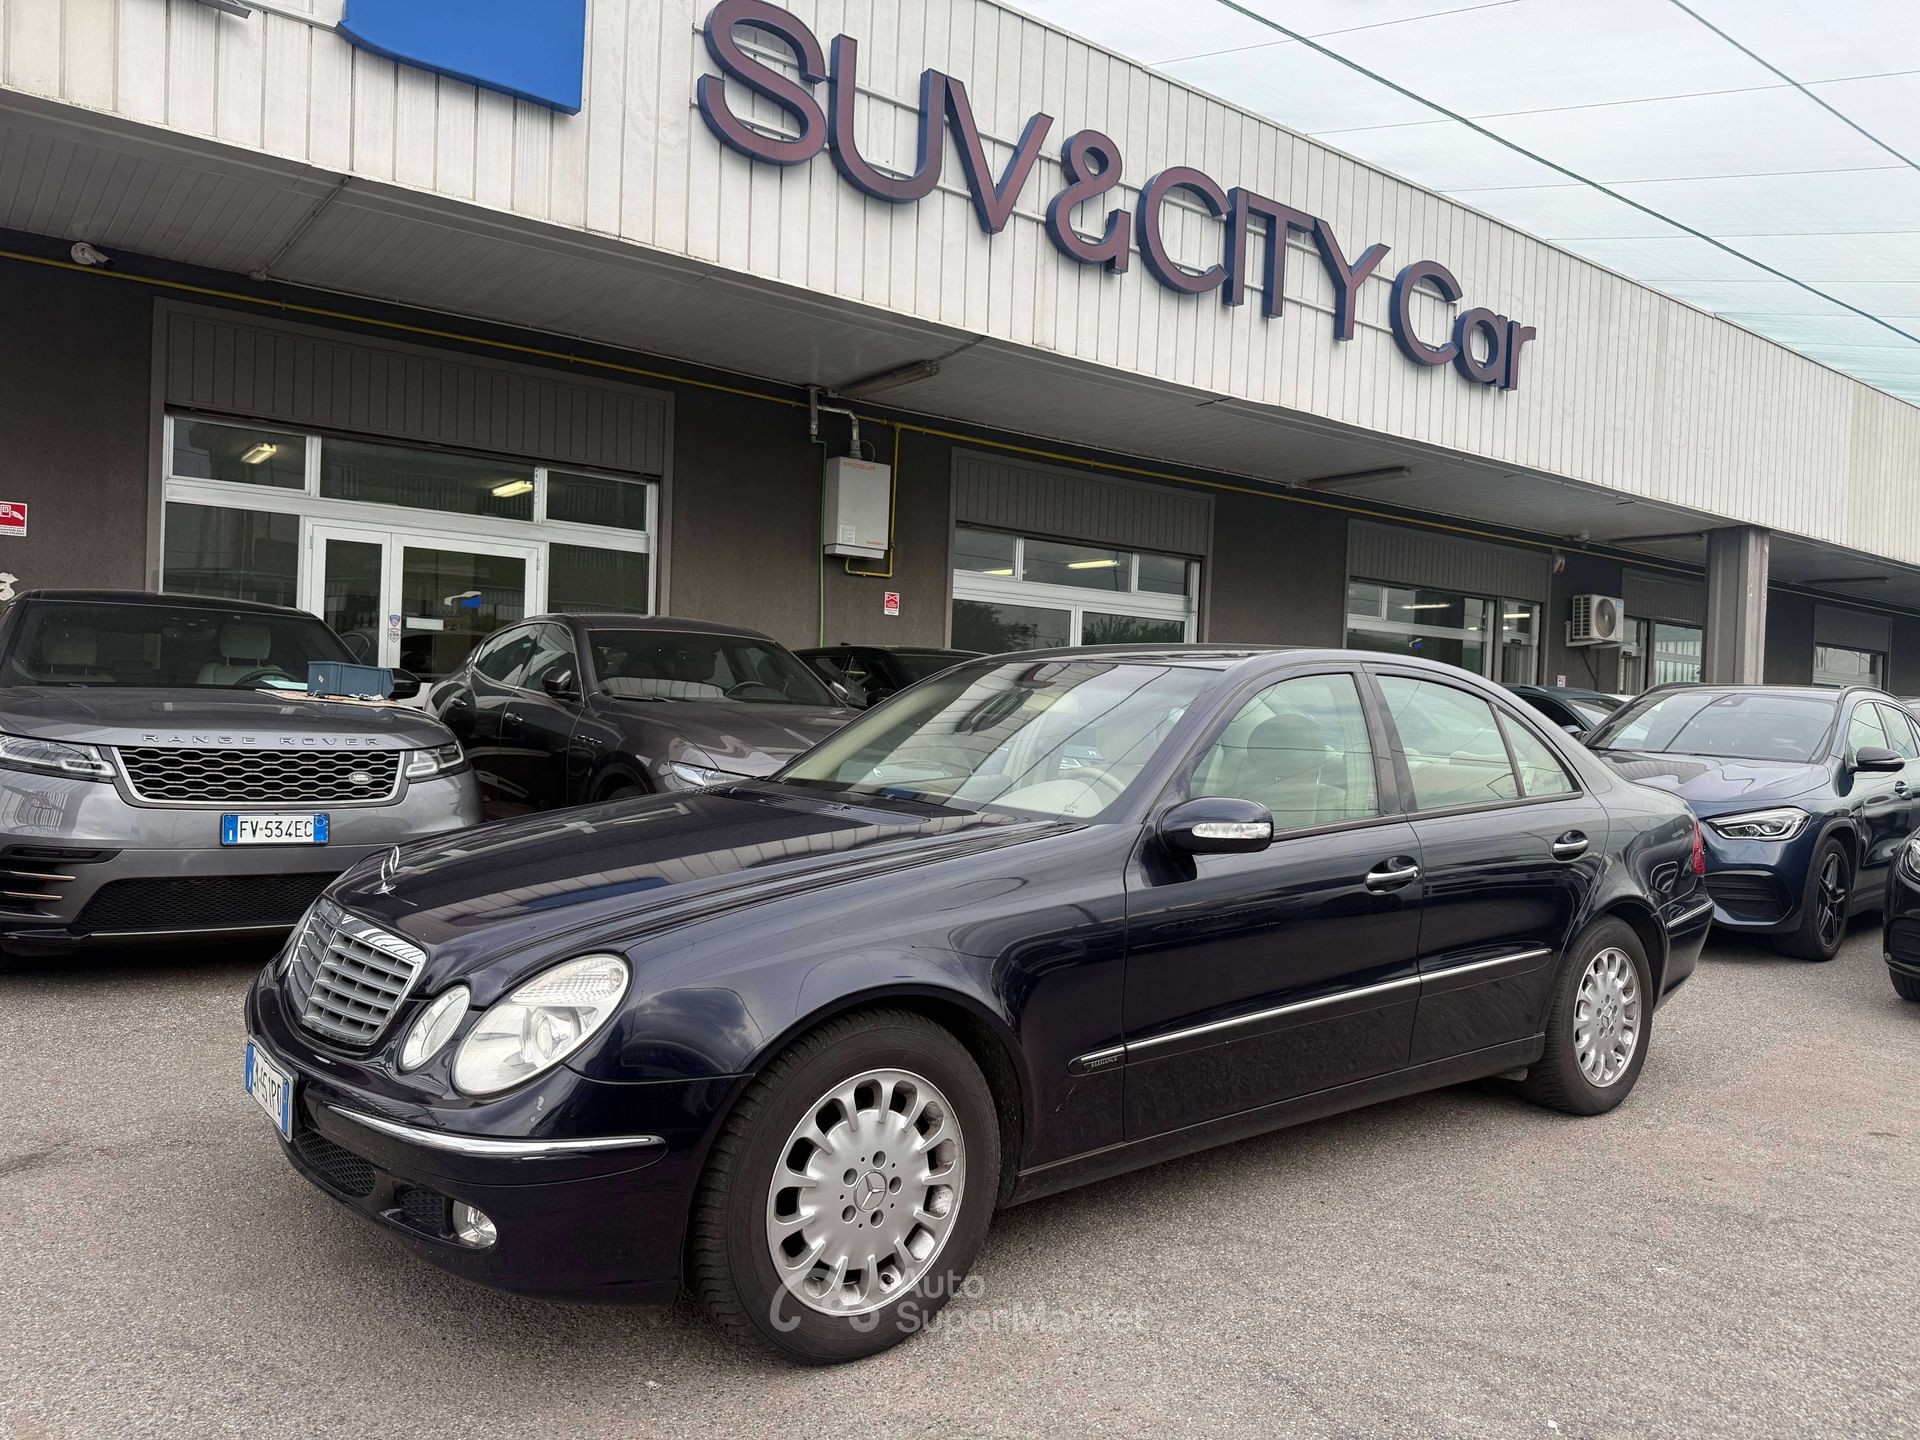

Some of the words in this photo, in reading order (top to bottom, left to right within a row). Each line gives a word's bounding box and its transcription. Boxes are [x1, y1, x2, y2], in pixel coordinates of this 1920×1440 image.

[1390, 260, 1536, 391] Car
[142, 734, 257, 745] RANGE
[279, 736, 381, 746] ROVER
